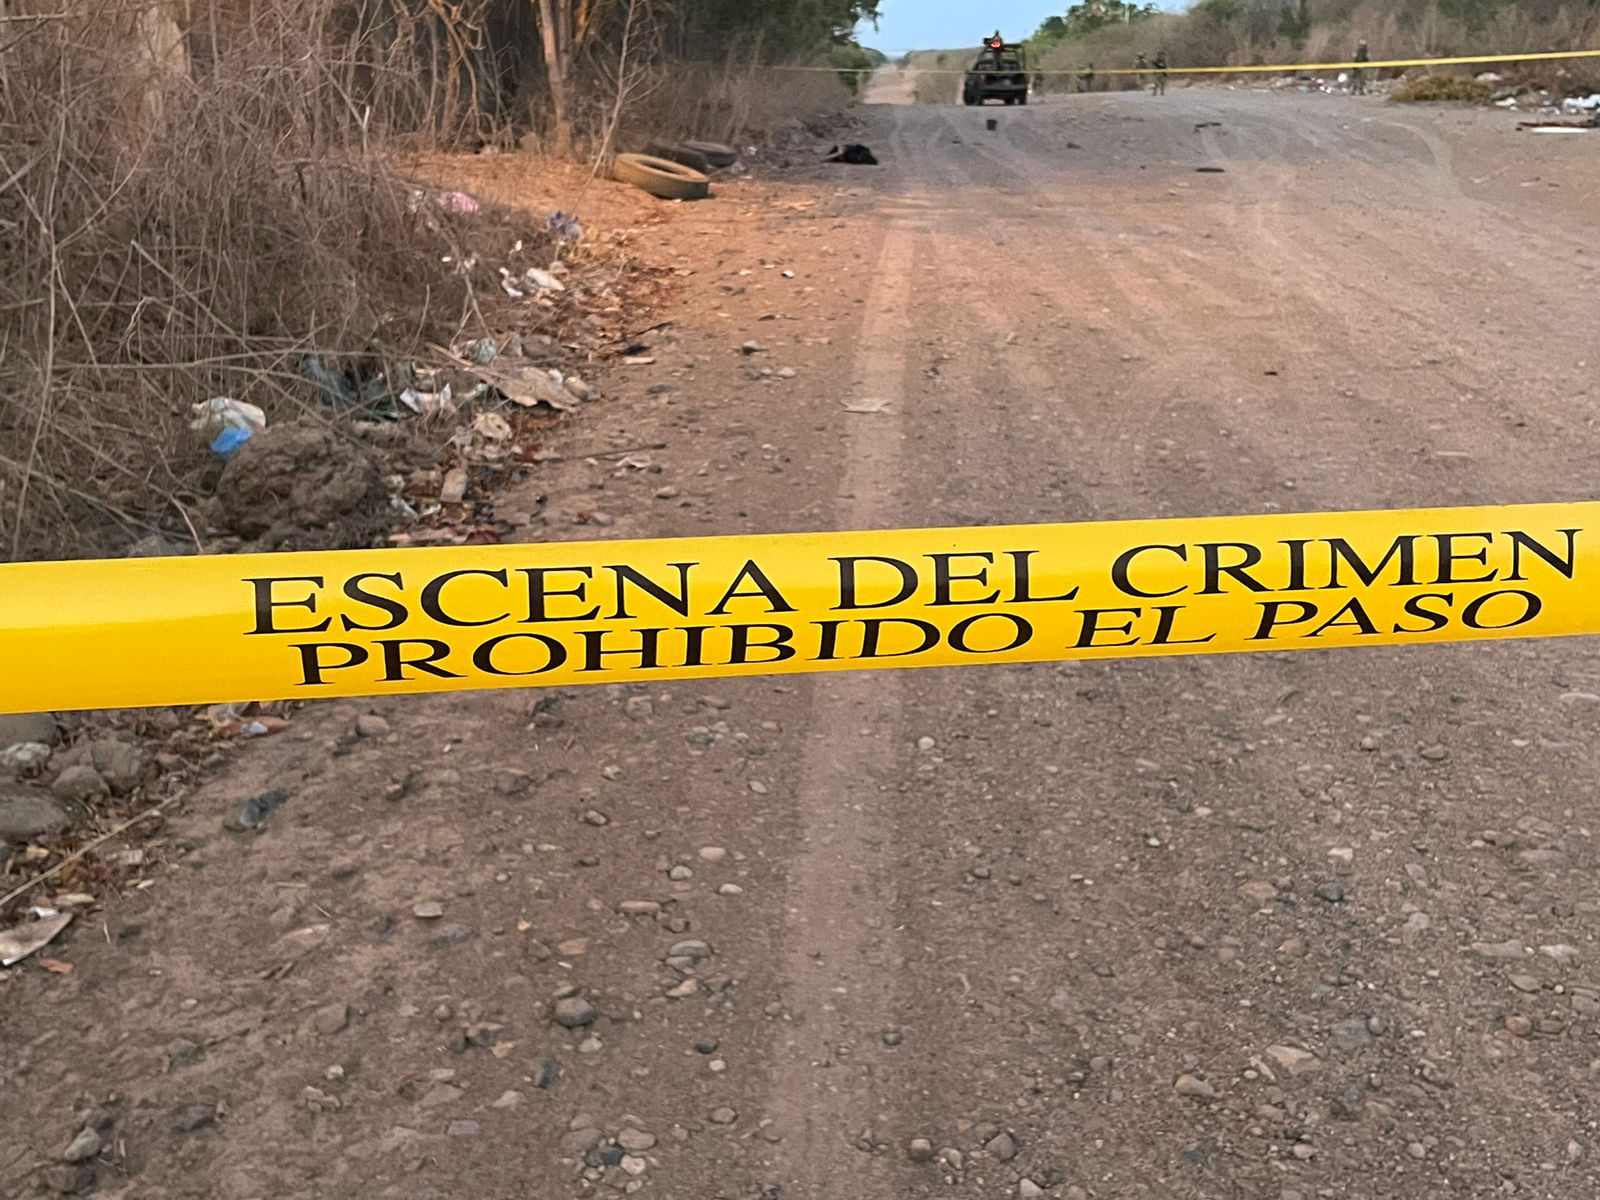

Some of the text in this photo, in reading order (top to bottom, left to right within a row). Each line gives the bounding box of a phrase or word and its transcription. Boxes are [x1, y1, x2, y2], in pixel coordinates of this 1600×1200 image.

[241, 528, 1585, 635] ESCENA DEL CRIMEN
[286, 589, 1542, 686] PROHIBIDO EL PASO
